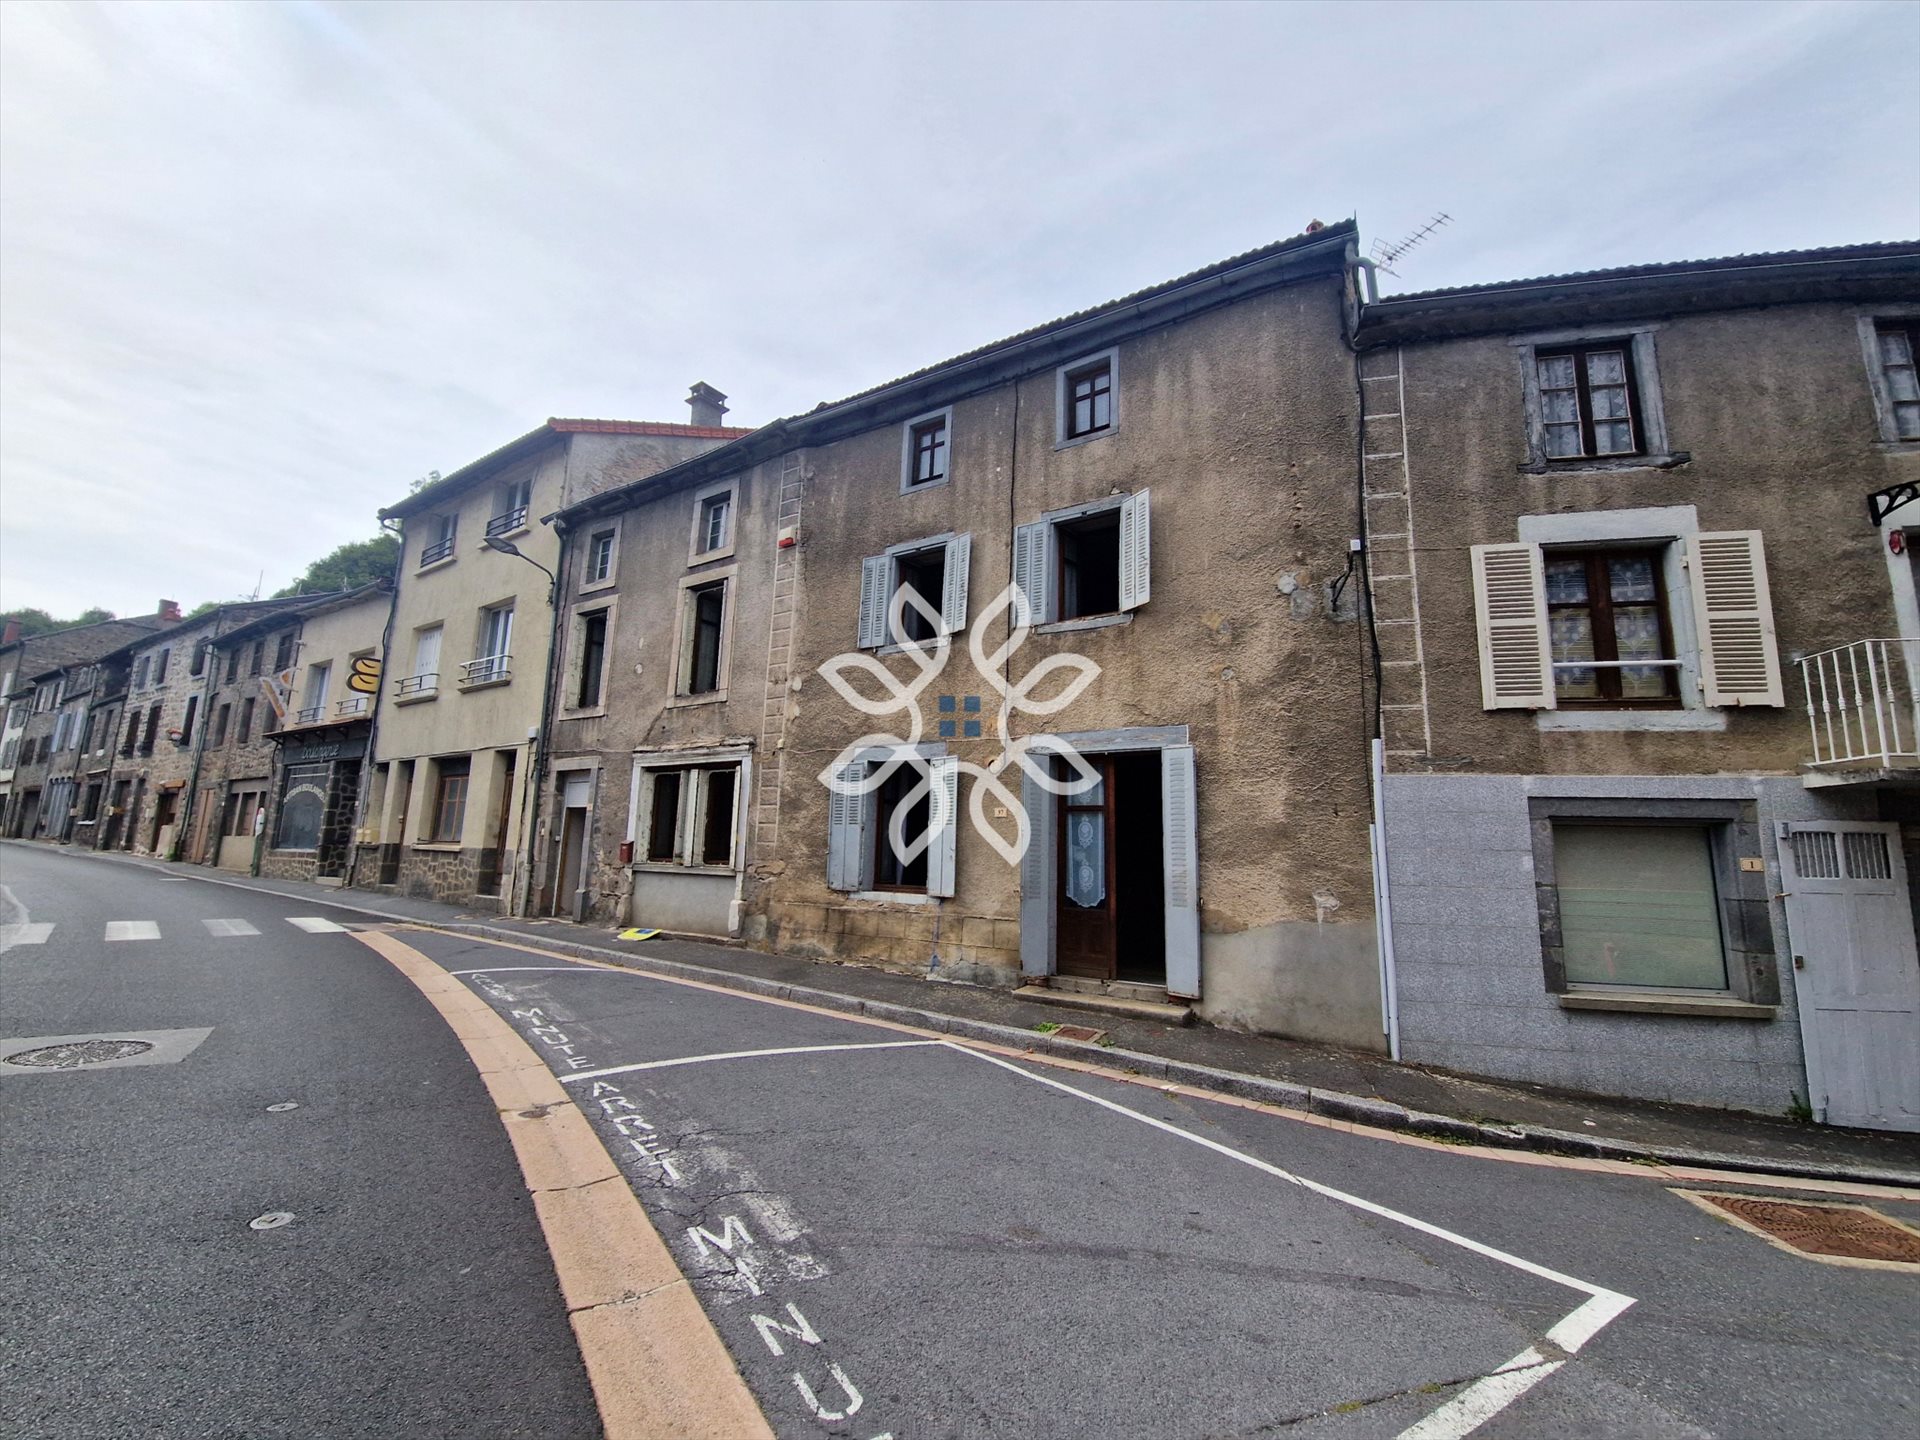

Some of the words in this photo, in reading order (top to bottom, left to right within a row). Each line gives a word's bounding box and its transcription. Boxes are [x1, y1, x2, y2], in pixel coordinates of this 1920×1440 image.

[511, 1007, 596, 1069] MINUTE
[593, 1081, 681, 1180] ARRET
[687, 1215, 893, 1440] MINU
